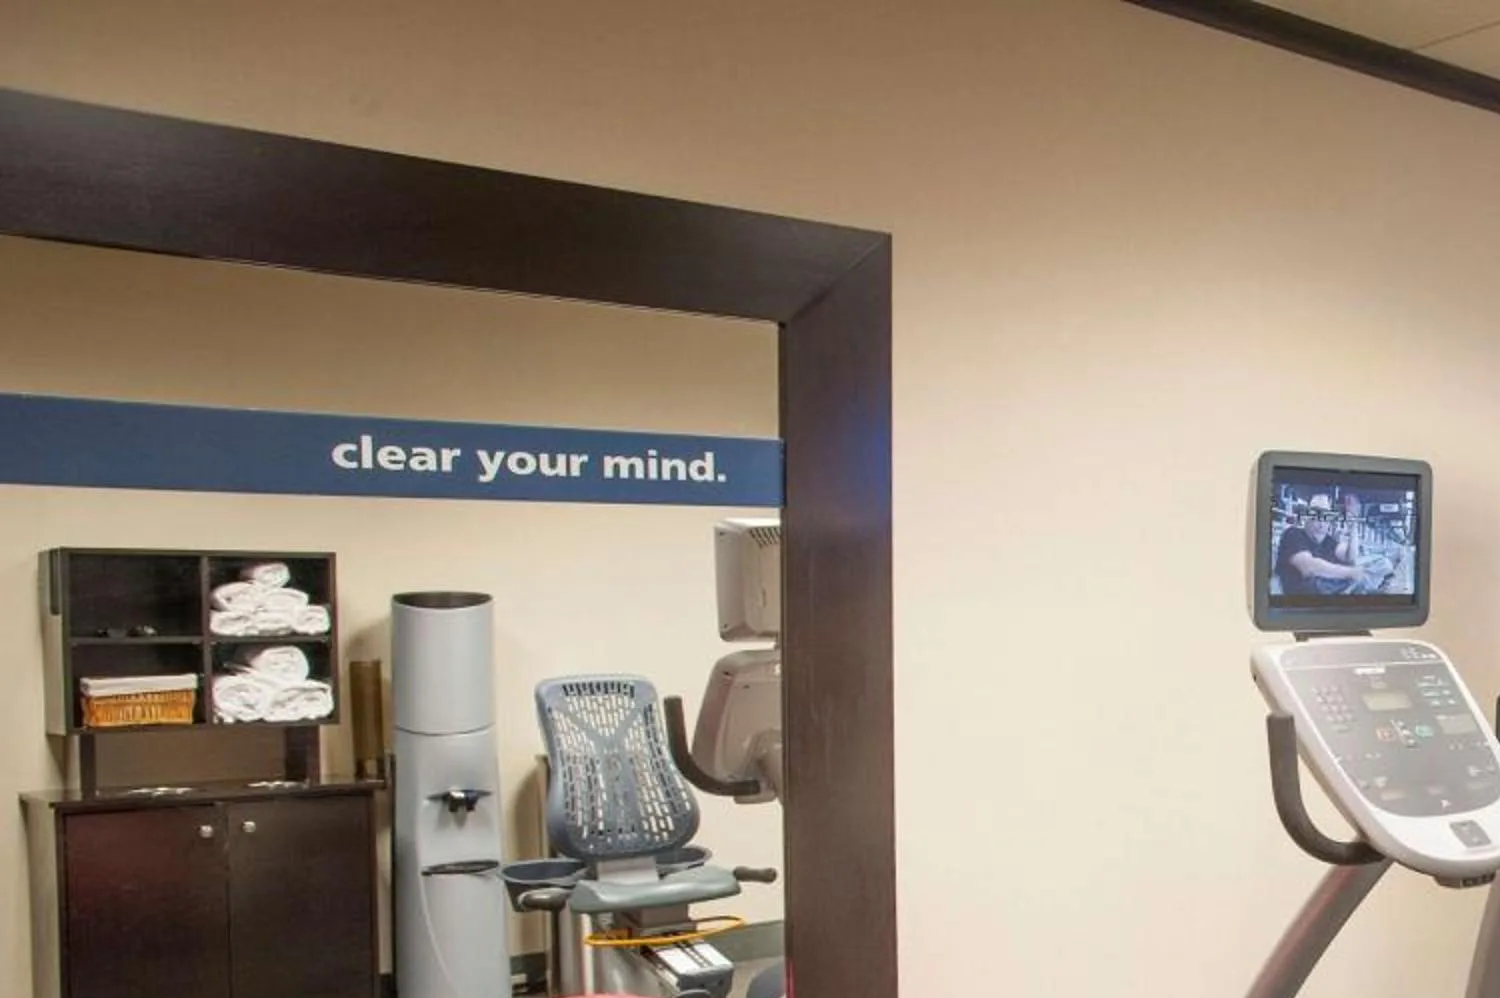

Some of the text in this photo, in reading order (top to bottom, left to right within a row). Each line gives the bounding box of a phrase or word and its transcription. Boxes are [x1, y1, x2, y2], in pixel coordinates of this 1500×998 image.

[331, 434, 727, 483] clear your mind.
